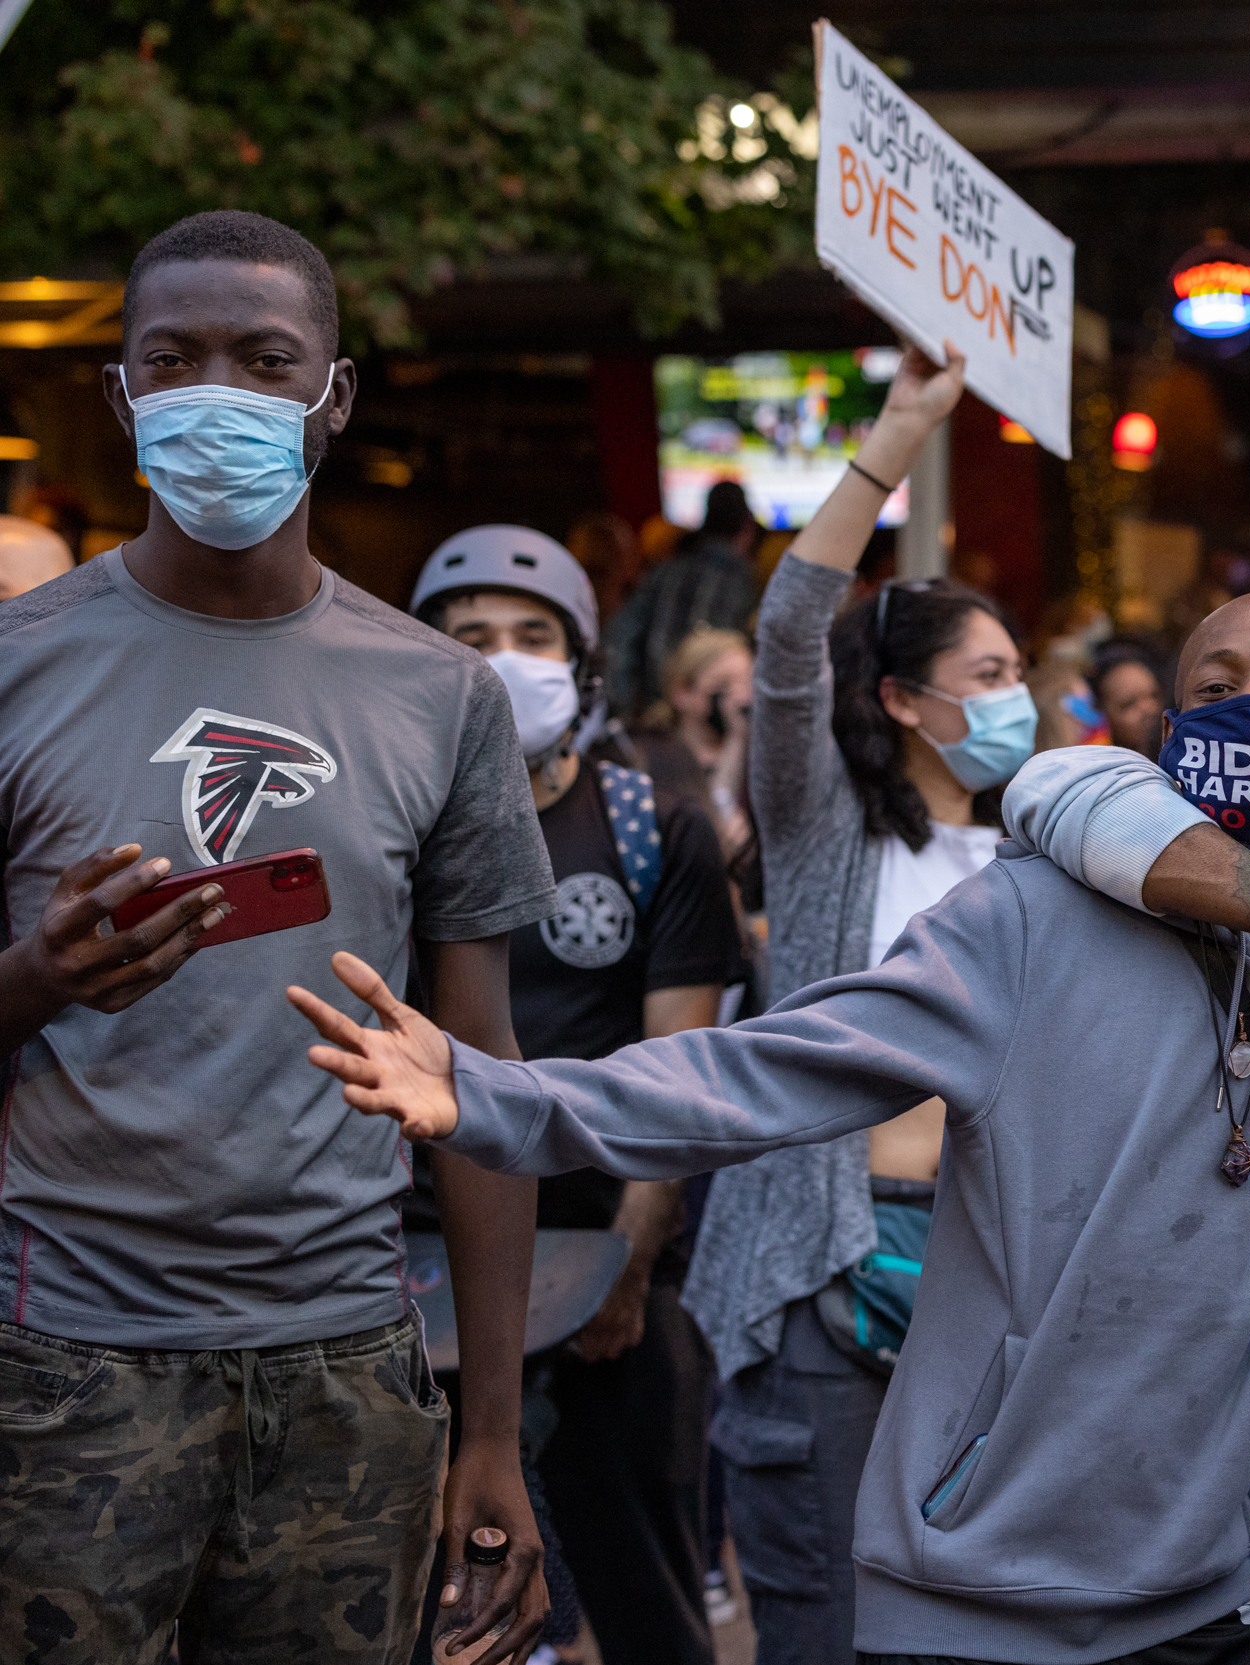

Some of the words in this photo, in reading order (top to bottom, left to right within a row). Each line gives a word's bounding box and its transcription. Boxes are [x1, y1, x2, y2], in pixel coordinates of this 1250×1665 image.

[835, 52, 1003, 224] UNEMPLOYMENT
[850, 114, 918, 190] JUST
[932, 180, 999, 261] WENT
[1010, 246, 1056, 312] UP
[838, 144, 917, 270] BYE
[940, 233, 1017, 357] DON
